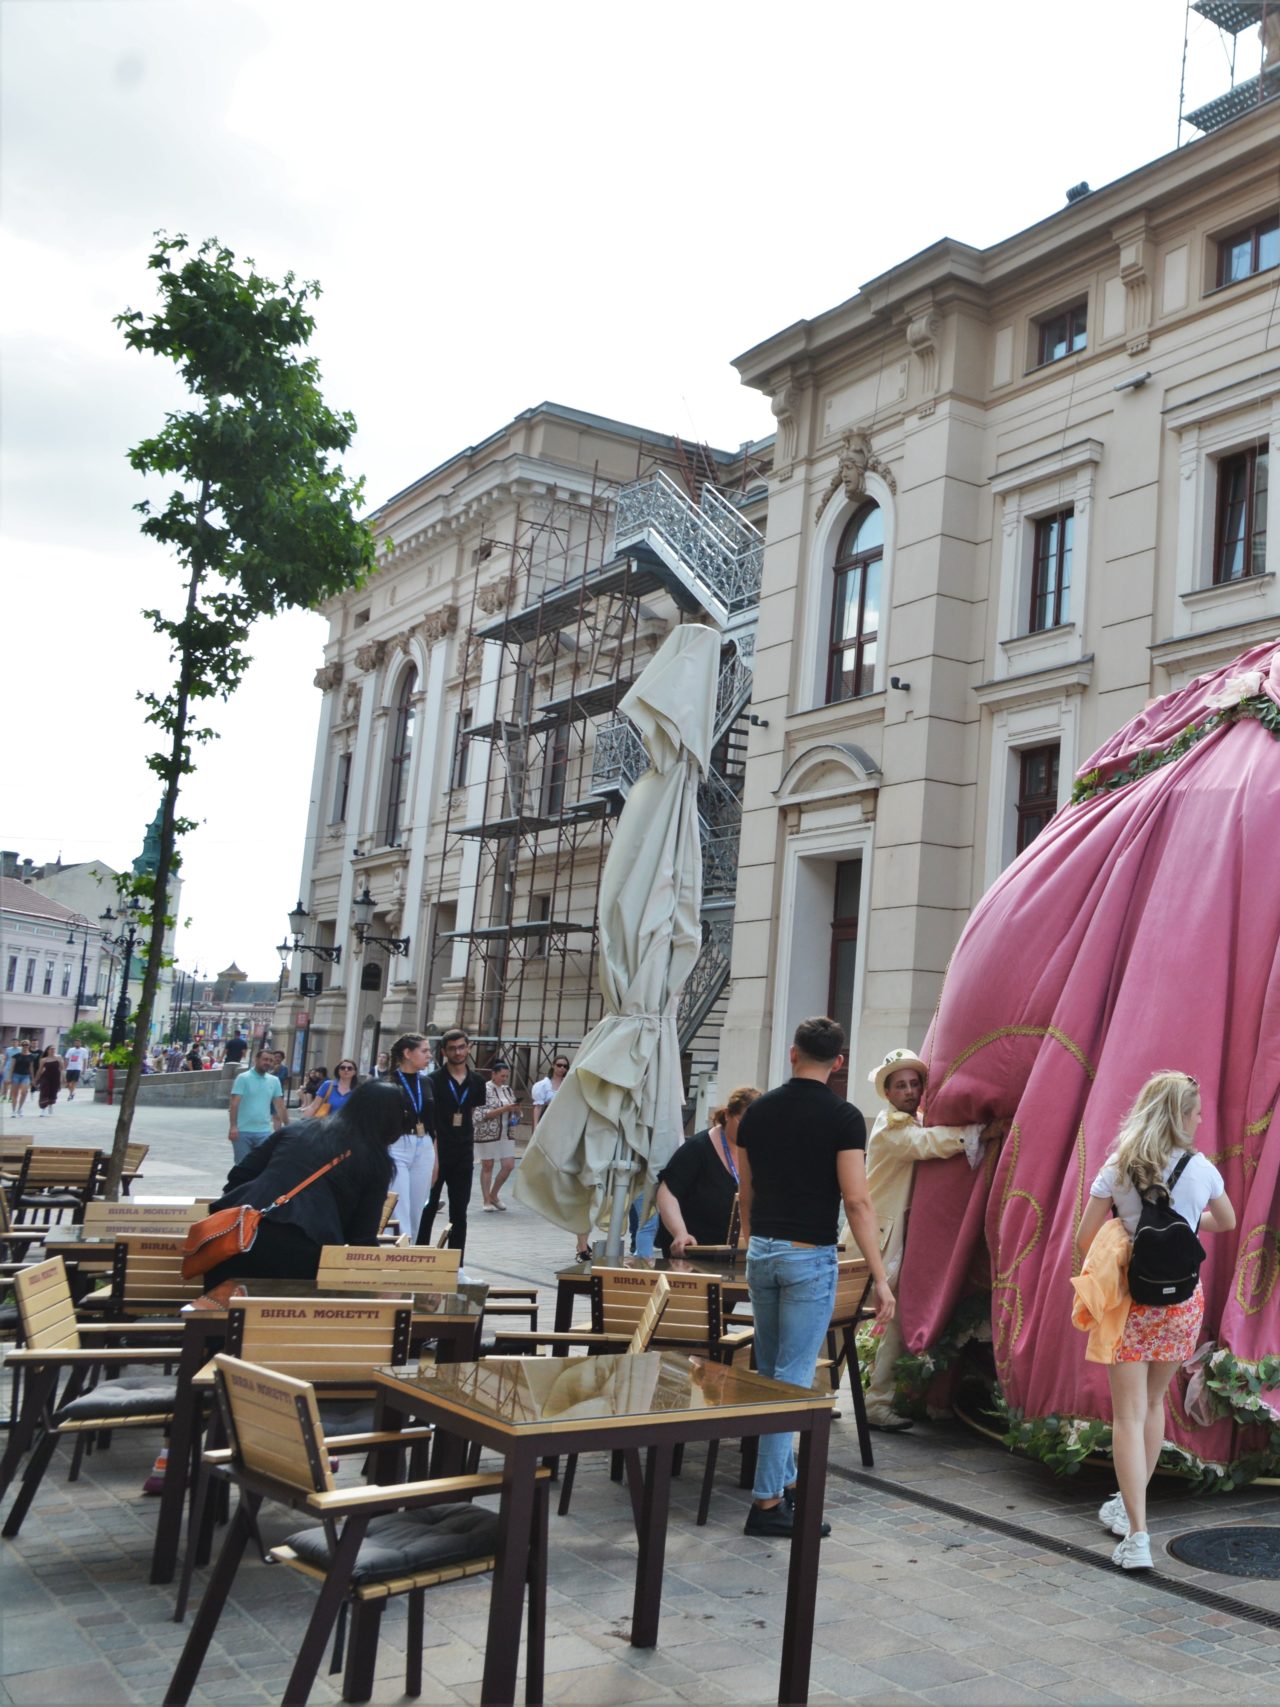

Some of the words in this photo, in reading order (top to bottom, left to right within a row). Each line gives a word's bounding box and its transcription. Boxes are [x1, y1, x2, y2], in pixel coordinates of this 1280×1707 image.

[141, 1242, 177, 1251] BIRRA
[345, 1252, 381, 1262] BIRRA
[385, 1253, 436, 1264] MORETTI
[613, 1276, 646, 1286] BIRRA
[650, 1279, 697, 1289] MRETTI
[260, 1309, 306, 1318] BIRRA
[313, 1309, 380, 1319] MORETTI
